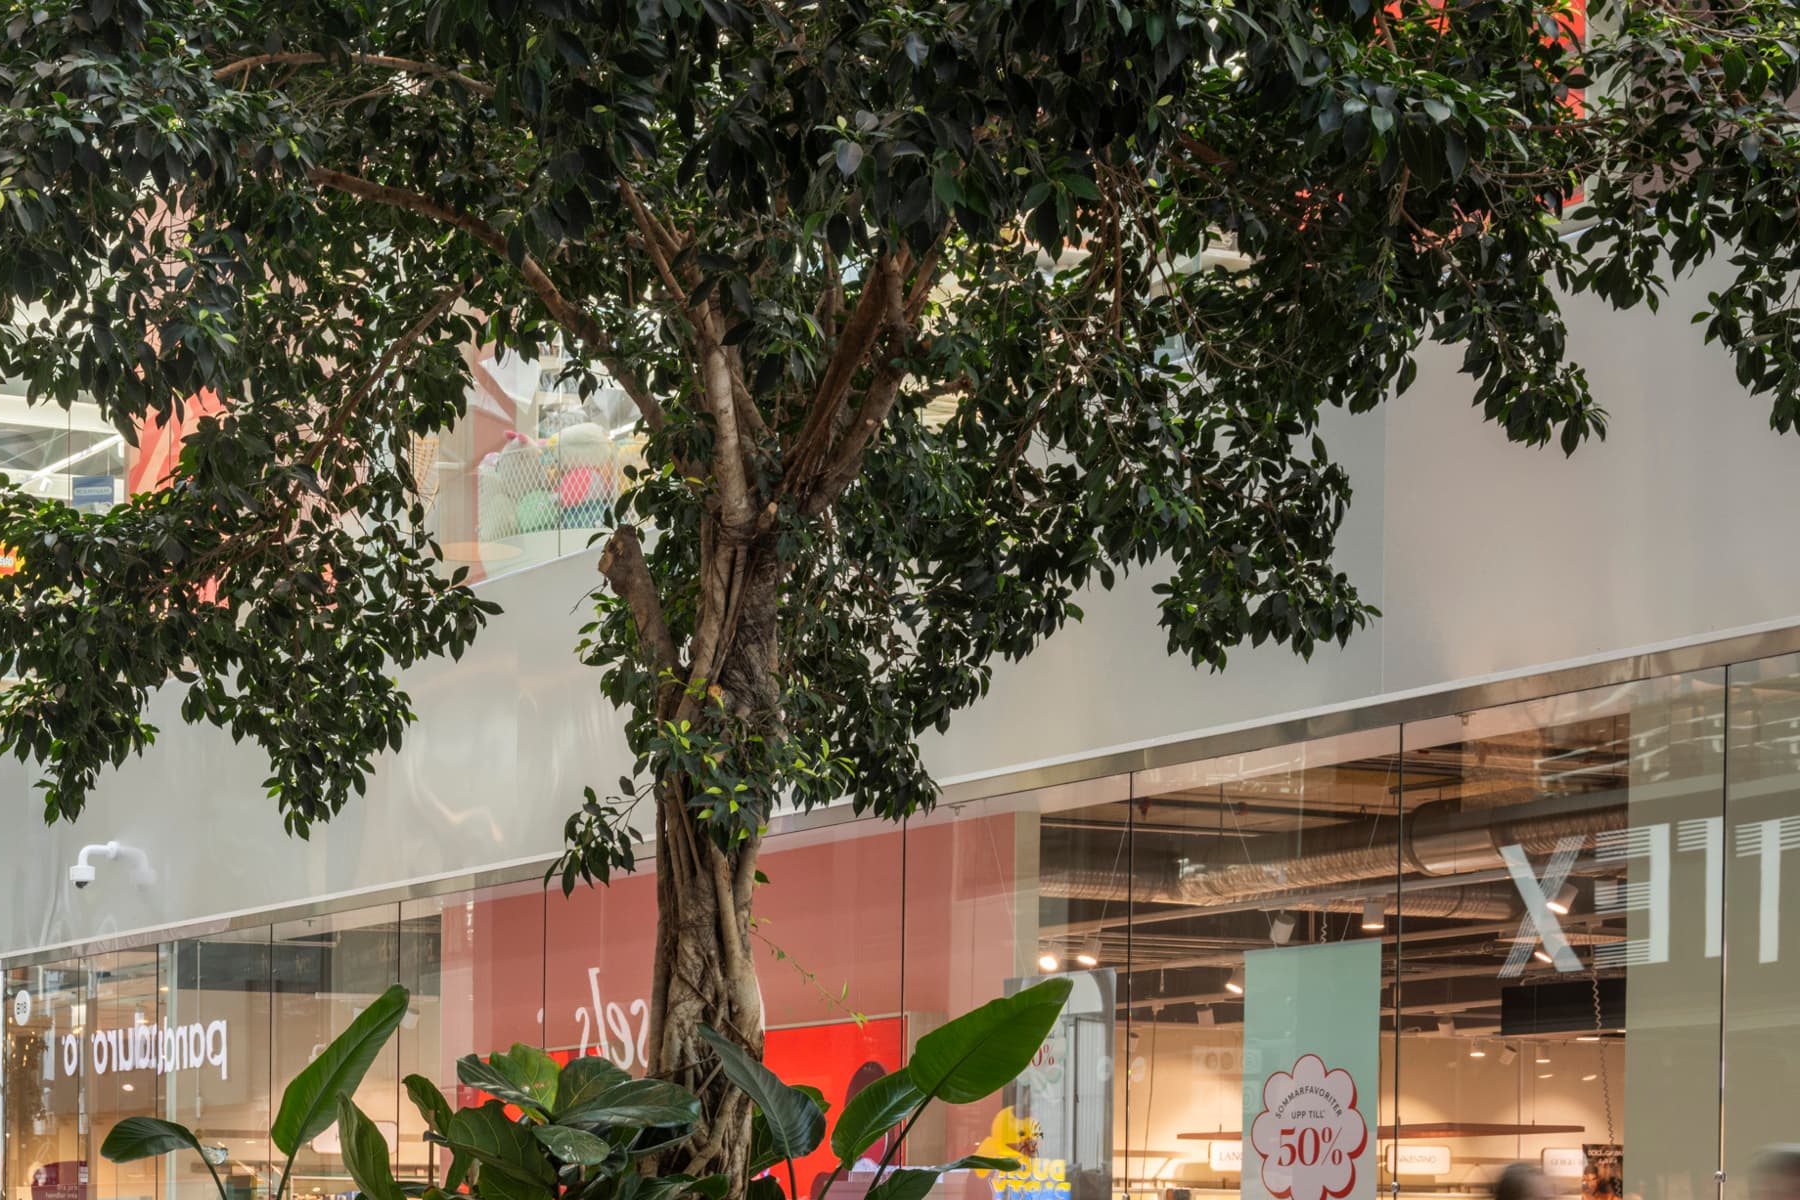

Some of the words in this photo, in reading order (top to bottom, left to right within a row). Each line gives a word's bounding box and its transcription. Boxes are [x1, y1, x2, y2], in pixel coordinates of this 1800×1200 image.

[1275, 1086, 1343, 1119] SOMMARFAVORITER
[1291, 1111, 1307, 1120] UPP
[1277, 1126, 1343, 1167] 50%
